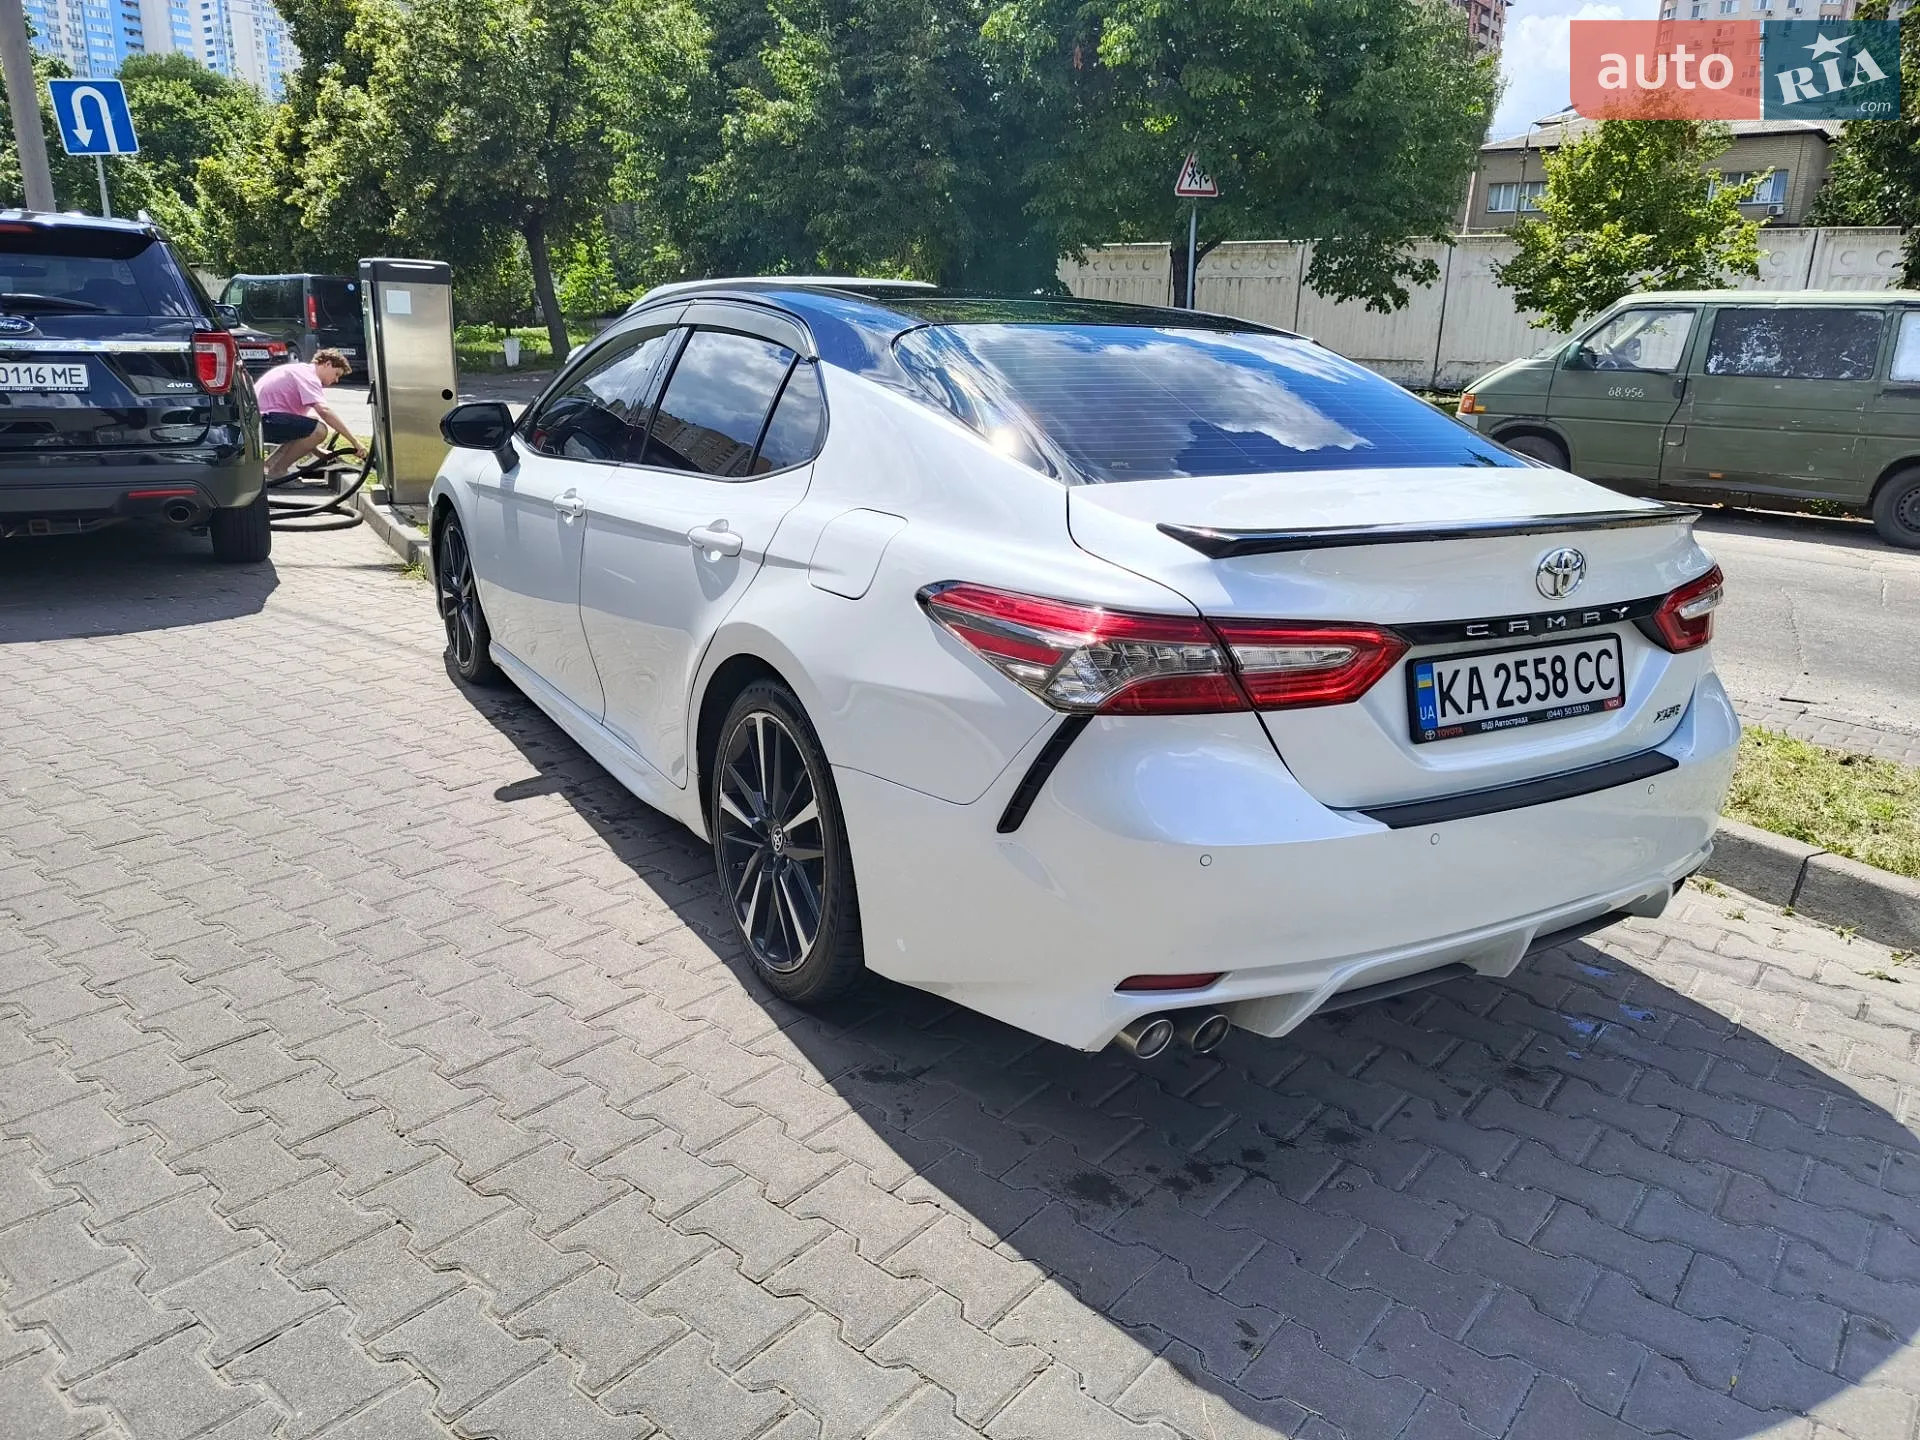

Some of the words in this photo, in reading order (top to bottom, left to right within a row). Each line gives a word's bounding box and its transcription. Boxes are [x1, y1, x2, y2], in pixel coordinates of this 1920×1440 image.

[51, 367, 83, 385] ME
[1466, 606, 1630, 636] CAMRY
[1437, 666, 1489, 718] KA
[1494, 655, 1568, 708] 2558
[1574, 649, 1615, 694] CC
[1420, 706, 1436, 720] UA
[1437, 728, 1464, 738] TOYOTA
